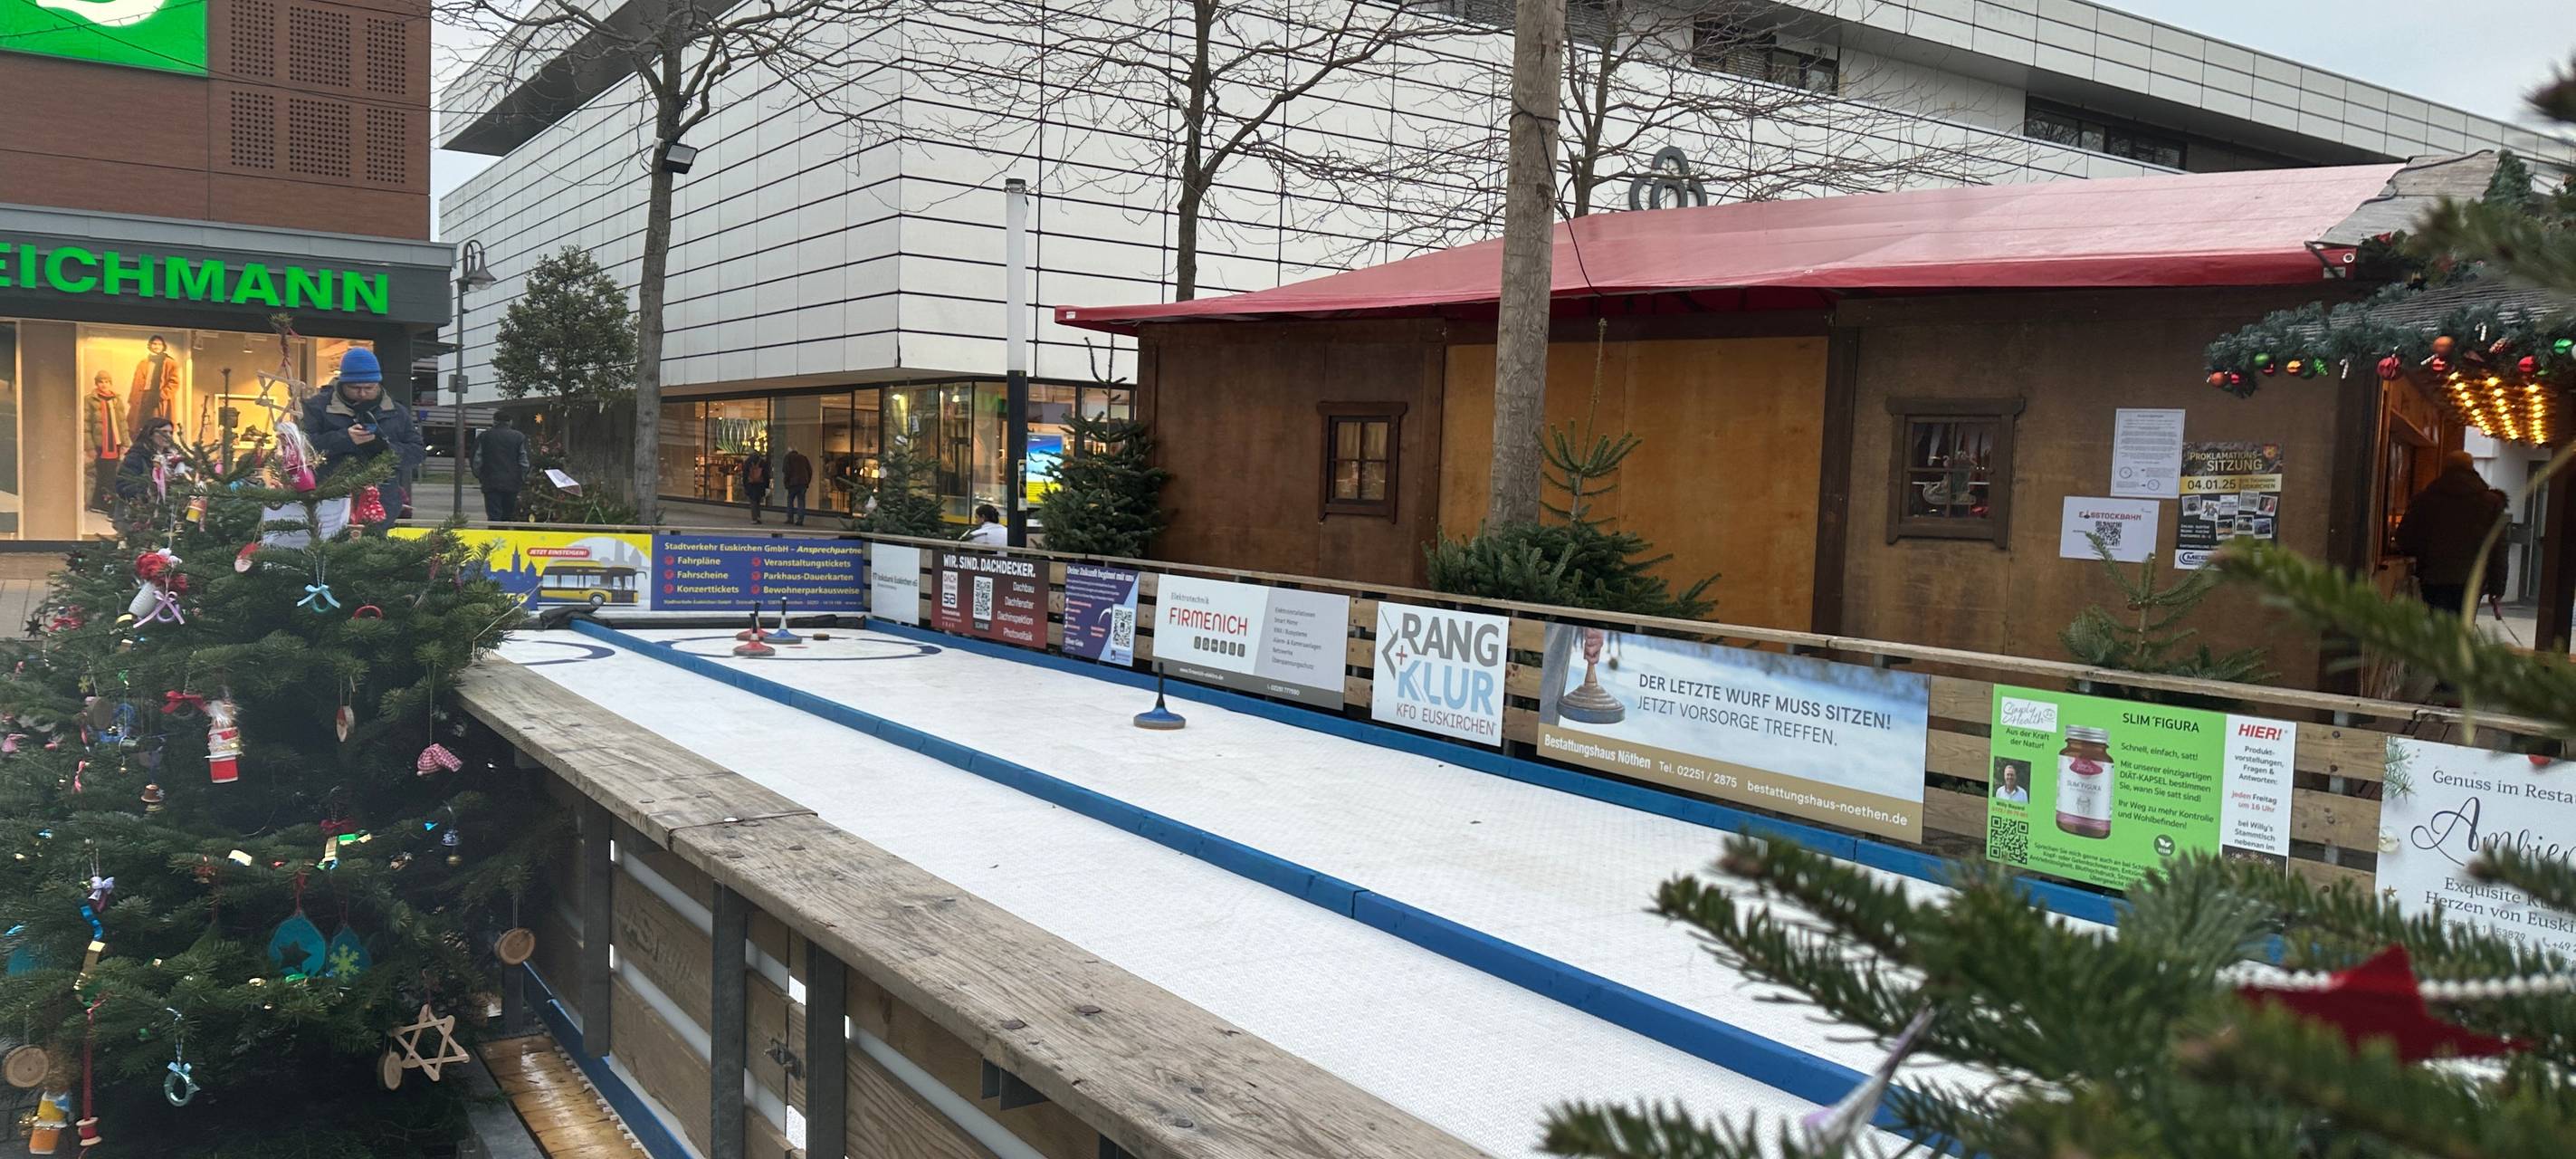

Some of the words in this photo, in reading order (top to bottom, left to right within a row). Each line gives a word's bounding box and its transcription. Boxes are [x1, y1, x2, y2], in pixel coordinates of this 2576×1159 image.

[2207, 459, 2263, 472] SITZUNG
[2188, 479, 2237, 490] 04.01.25
[664, 542, 718, 551] Stadtverkehr
[720, 543, 762, 552] Euskirchen
[764, 545, 788, 553] GmbH
[677, 556, 721, 566] Fahrpläne
[763, 559, 851, 569] Veranstaltungstickets
[943, 554, 959, 569] WIR.
[959, 556, 979, 570] SIND.
[980, 558, 1036, 578] DACHDECKER.
[677, 570, 729, 580] Fahrscheine
[763, 571, 854, 581] Parkhaus-Dauerkarten
[1066, 565, 1080, 575] Deine
[1080, 567, 1098, 578] Zukunft
[1098, 569, 1116, 581] beginnt
[677, 585, 739, 593] Konzerttickets
[763, 586, 860, 596] Bewohnerparkausweise
[1013, 581, 1035, 594] Dachbau
[1005, 596, 1035, 608] Dachfenster
[1170, 592, 1209, 605] Elektrotechnik
[997, 610, 1034, 625] Dachinspektion
[1169, 607, 1248, 637] FIRMENICH
[1003, 627, 1033, 641] Photovoltaik
[1402, 612, 1500, 667] RANG
[1398, 660, 1494, 716] KLUR
[1639, 674, 1665, 691] DER
[1670, 679, 1721, 701] LETZTE
[1726, 687, 1770, 709] WURF
[1775, 695, 1820, 718] MUSS
[1826, 704, 1891, 730] SITZEN!
[1396, 703, 1417, 720] KFO
[1422, 708, 1494, 736] EUSKIRCHEN
[1637, 695, 1676, 715] JETZT
[1680, 703, 1759, 732] VORSORGE
[1764, 717, 1837, 746] TREFFEN.
[2006, 727, 2018, 736] Aus
[2019, 730, 2032, 738] der
[2032, 732, 2050, 741] Kraft
[2238, 723, 2283, 741] HIER!
[2010, 738, 2022, 747] der
[2023, 740, 2045, 750] Natur!
[2245, 745, 2275, 756] Produkt-
[2121, 742, 2149, 754] Schnell,
[2151, 746, 2180, 759] einfach,
[2180, 752, 2199, 761] satt!
[2235, 755, 2285, 769] vorstellungen,
[2243, 764, 2267, 774] Fragen
[2121, 760, 2132, 769] Mit
[2133, 762, 2161, 773] unserer
[2162, 767, 2212, 781] einzigartigen
[1544, 733, 1616, 762] Bestattungshaus
[1617, 750, 1651, 770] Nöthen
[1658, 761, 1675, 775] Tel.
[1677, 764, 1705, 781] 02251
[1706, 771, 1712, 782] /
[1713, 772, 1738, 789] 2875
[1747, 780, 1908, 827] bestattungshaus-noethen.de
[2120, 770, 2168, 786] DIÄT-KAPSEL
[2169, 779, 2211, 793] bestimmen
[2238, 773, 2278, 785] Antworten:
[2119, 781, 2132, 791] Sie,
[2133, 786, 2153, 794] wann
[2154, 787, 2166, 797] Sie
[2167, 790, 2181, 800] satt
[2182, 793, 2202, 803] sind!
[2432, 770, 2491, 791] Genuss
[2497, 780, 2519, 796] im
[2525, 783, 2576, 805] Resta
[2231, 790, 2251, 800] jeden
[2252, 793, 2277, 806] Freitag
[2118, 799, 2129, 807] Ihr
[2130, 801, 2147, 812] Weg
[2148, 805, 2157, 813] zu
[2158, 807, 2178, 816] mehr
[2179, 809, 2215, 823] Kontrolle
[2251, 803, 2261, 811] 16
[2262, 804, 2275, 813] Uhr
[2117, 810, 2132, 819] und
[2133, 813, 2188, 829] Wohlbefinden!
[2237, 819, 2249, 828] bei
[2235, 828, 2275, 842] Stammtisch
[2034, 842, 2059, 852] Sprechen
[2068, 849, 2082, 857] mich
[2234, 838, 2265, 849] nebenan
[2266, 843, 2275, 851] im
[2445, 876, 2521, 905] Exquisite
[2425, 890, 2484, 915] Herzen
[2489, 907, 2521, 923] von
[2527, 911, 2576, 934] Euski
[2495, 927, 2526, 942] 53879
